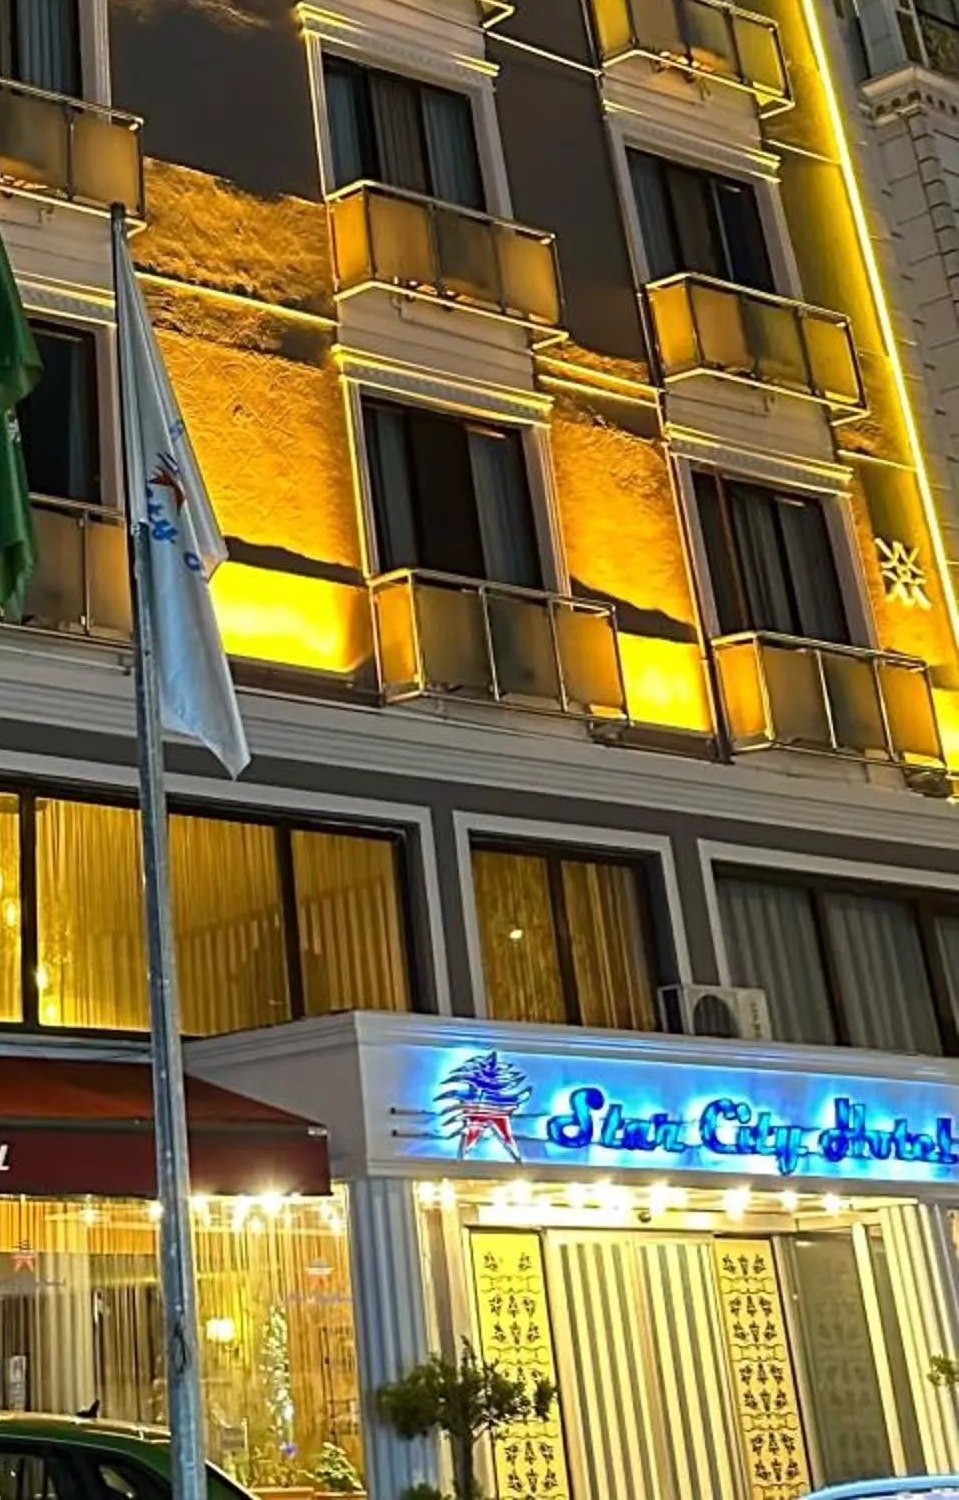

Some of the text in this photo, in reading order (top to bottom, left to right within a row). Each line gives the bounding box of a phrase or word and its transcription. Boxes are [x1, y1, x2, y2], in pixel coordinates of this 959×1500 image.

[546, 1087, 959, 1176] Star City Hotel
